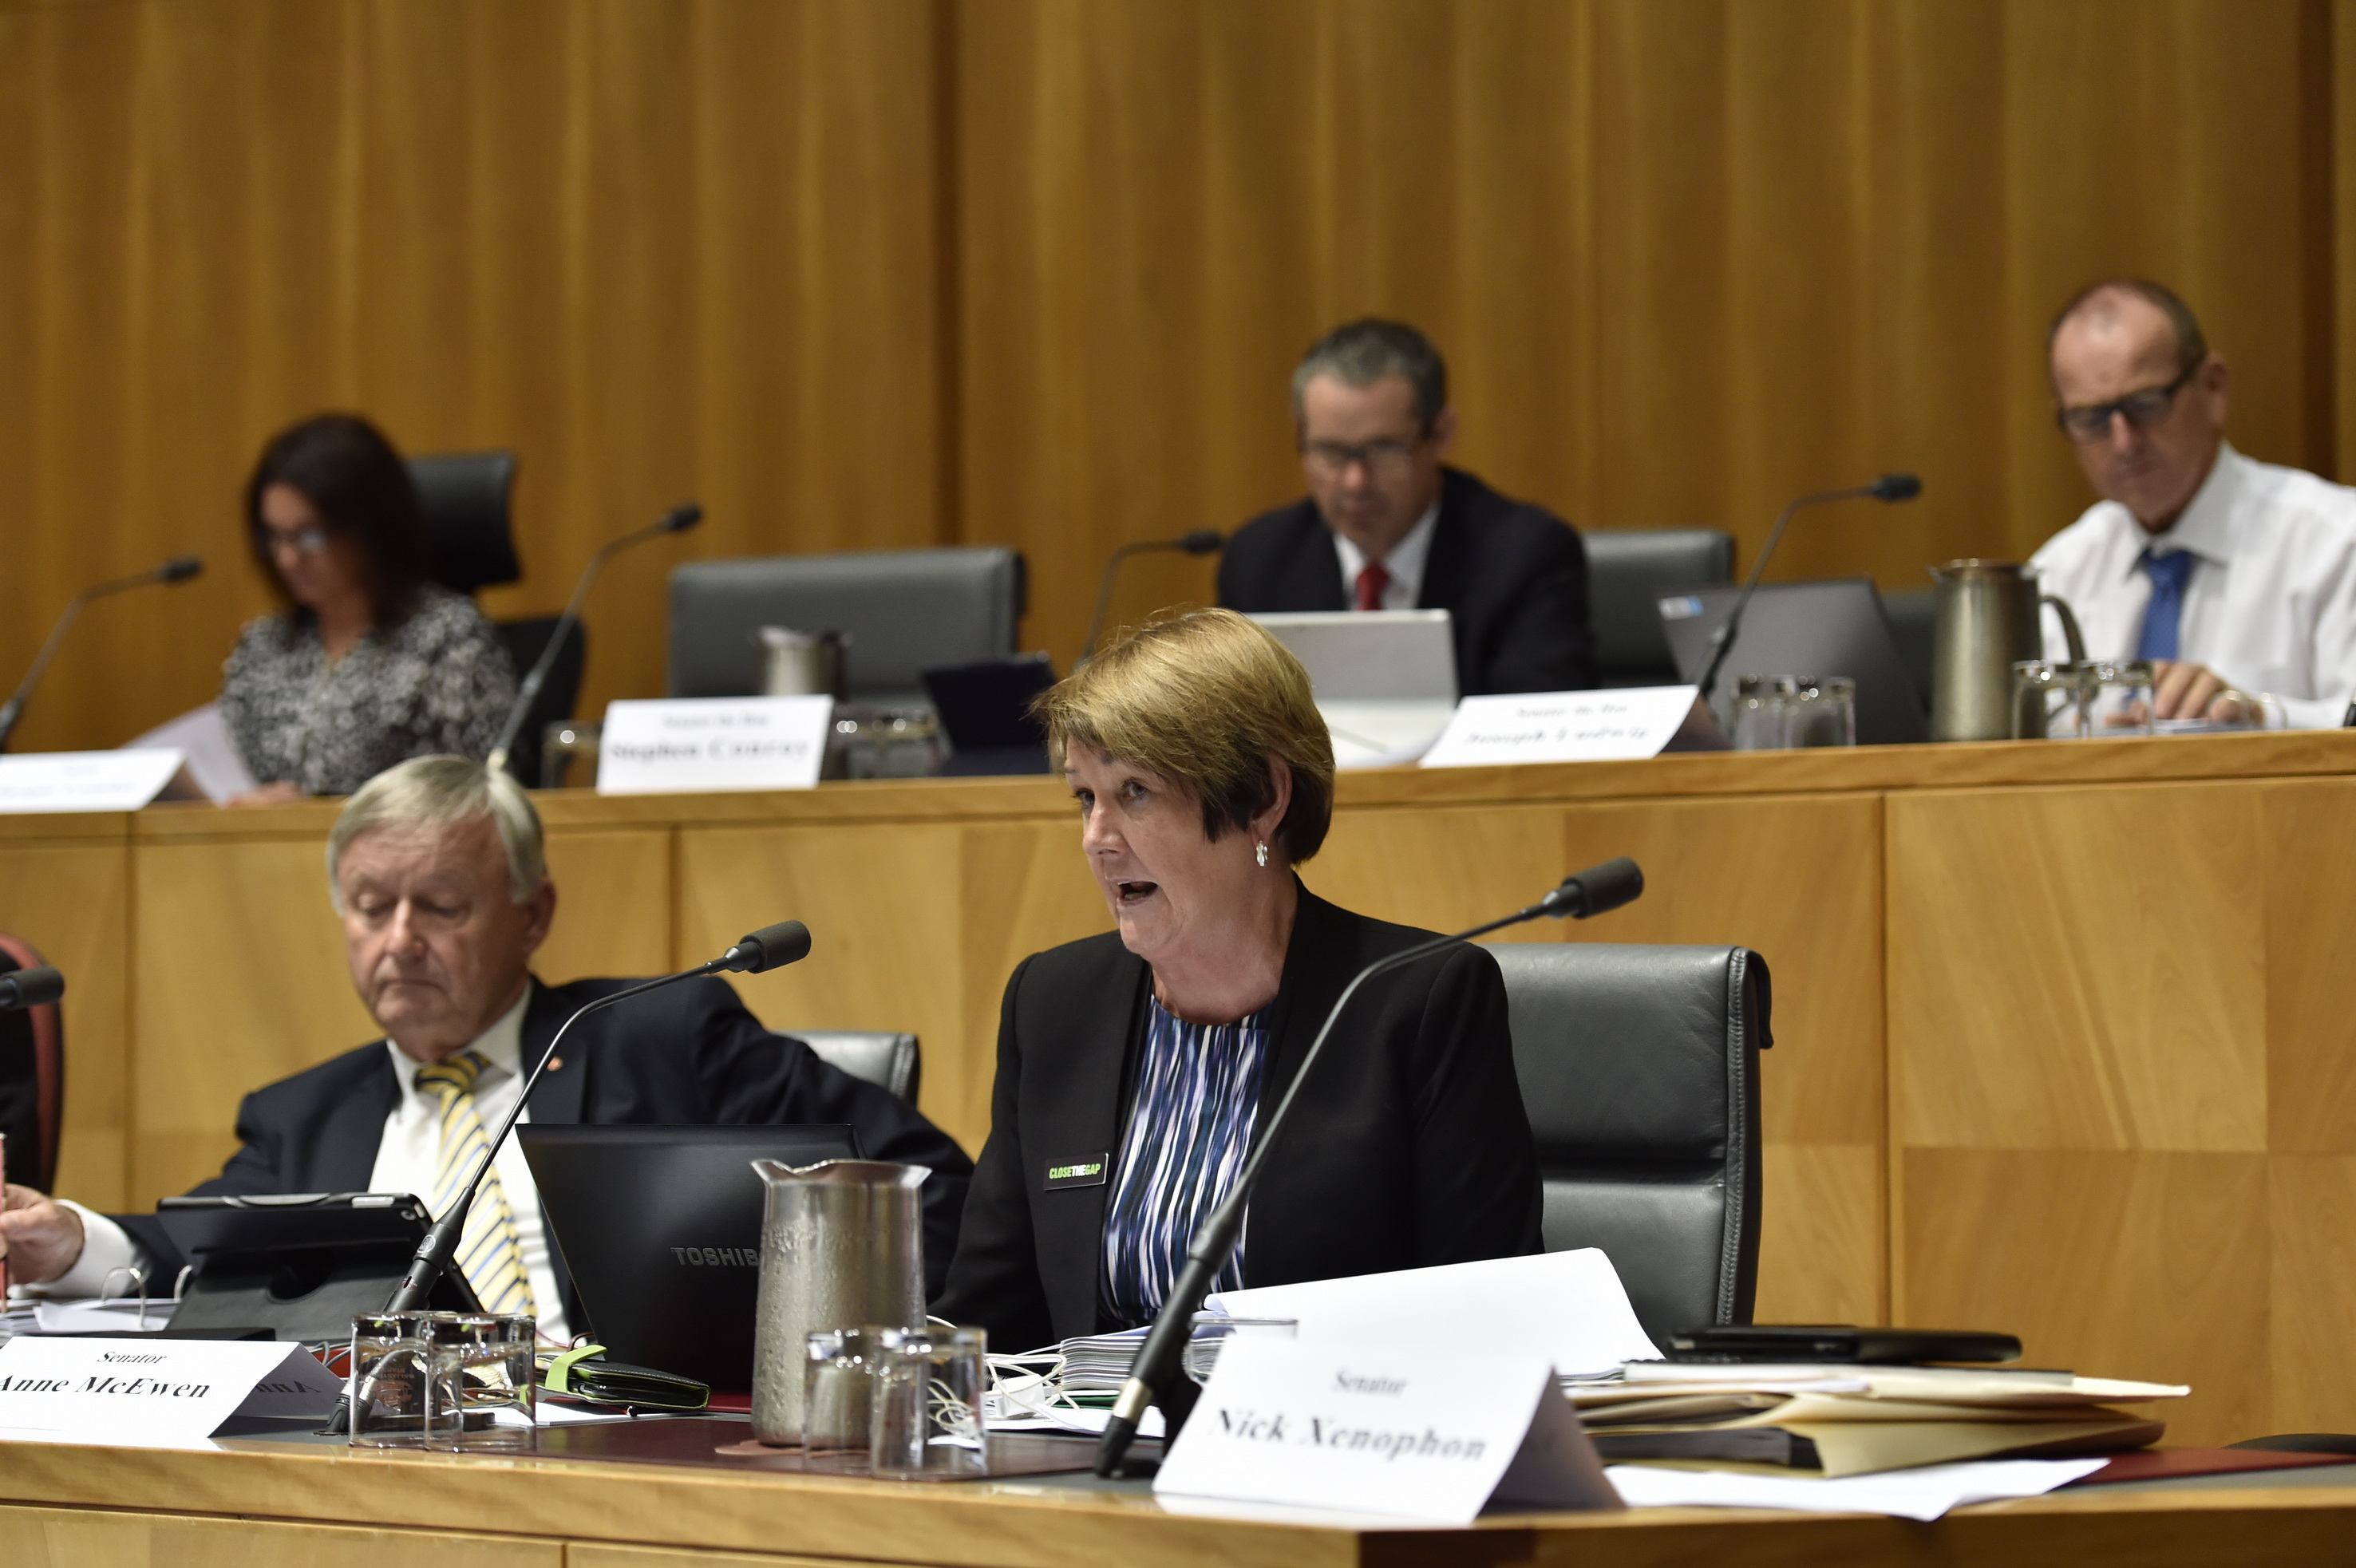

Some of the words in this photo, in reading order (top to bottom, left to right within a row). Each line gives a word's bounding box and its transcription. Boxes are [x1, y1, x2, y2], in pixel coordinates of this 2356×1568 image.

[670, 1246, 761, 1266] TOSHIB
[97, 1351, 168, 1365] Senator
[0, 1374, 69, 1392] Anne
[74, 1376, 211, 1398] McEwen
[1333, 1369, 1409, 1396] Senator
[1208, 1409, 1287, 1441] Nick
[1299, 1417, 1488, 1462] Xenophon
